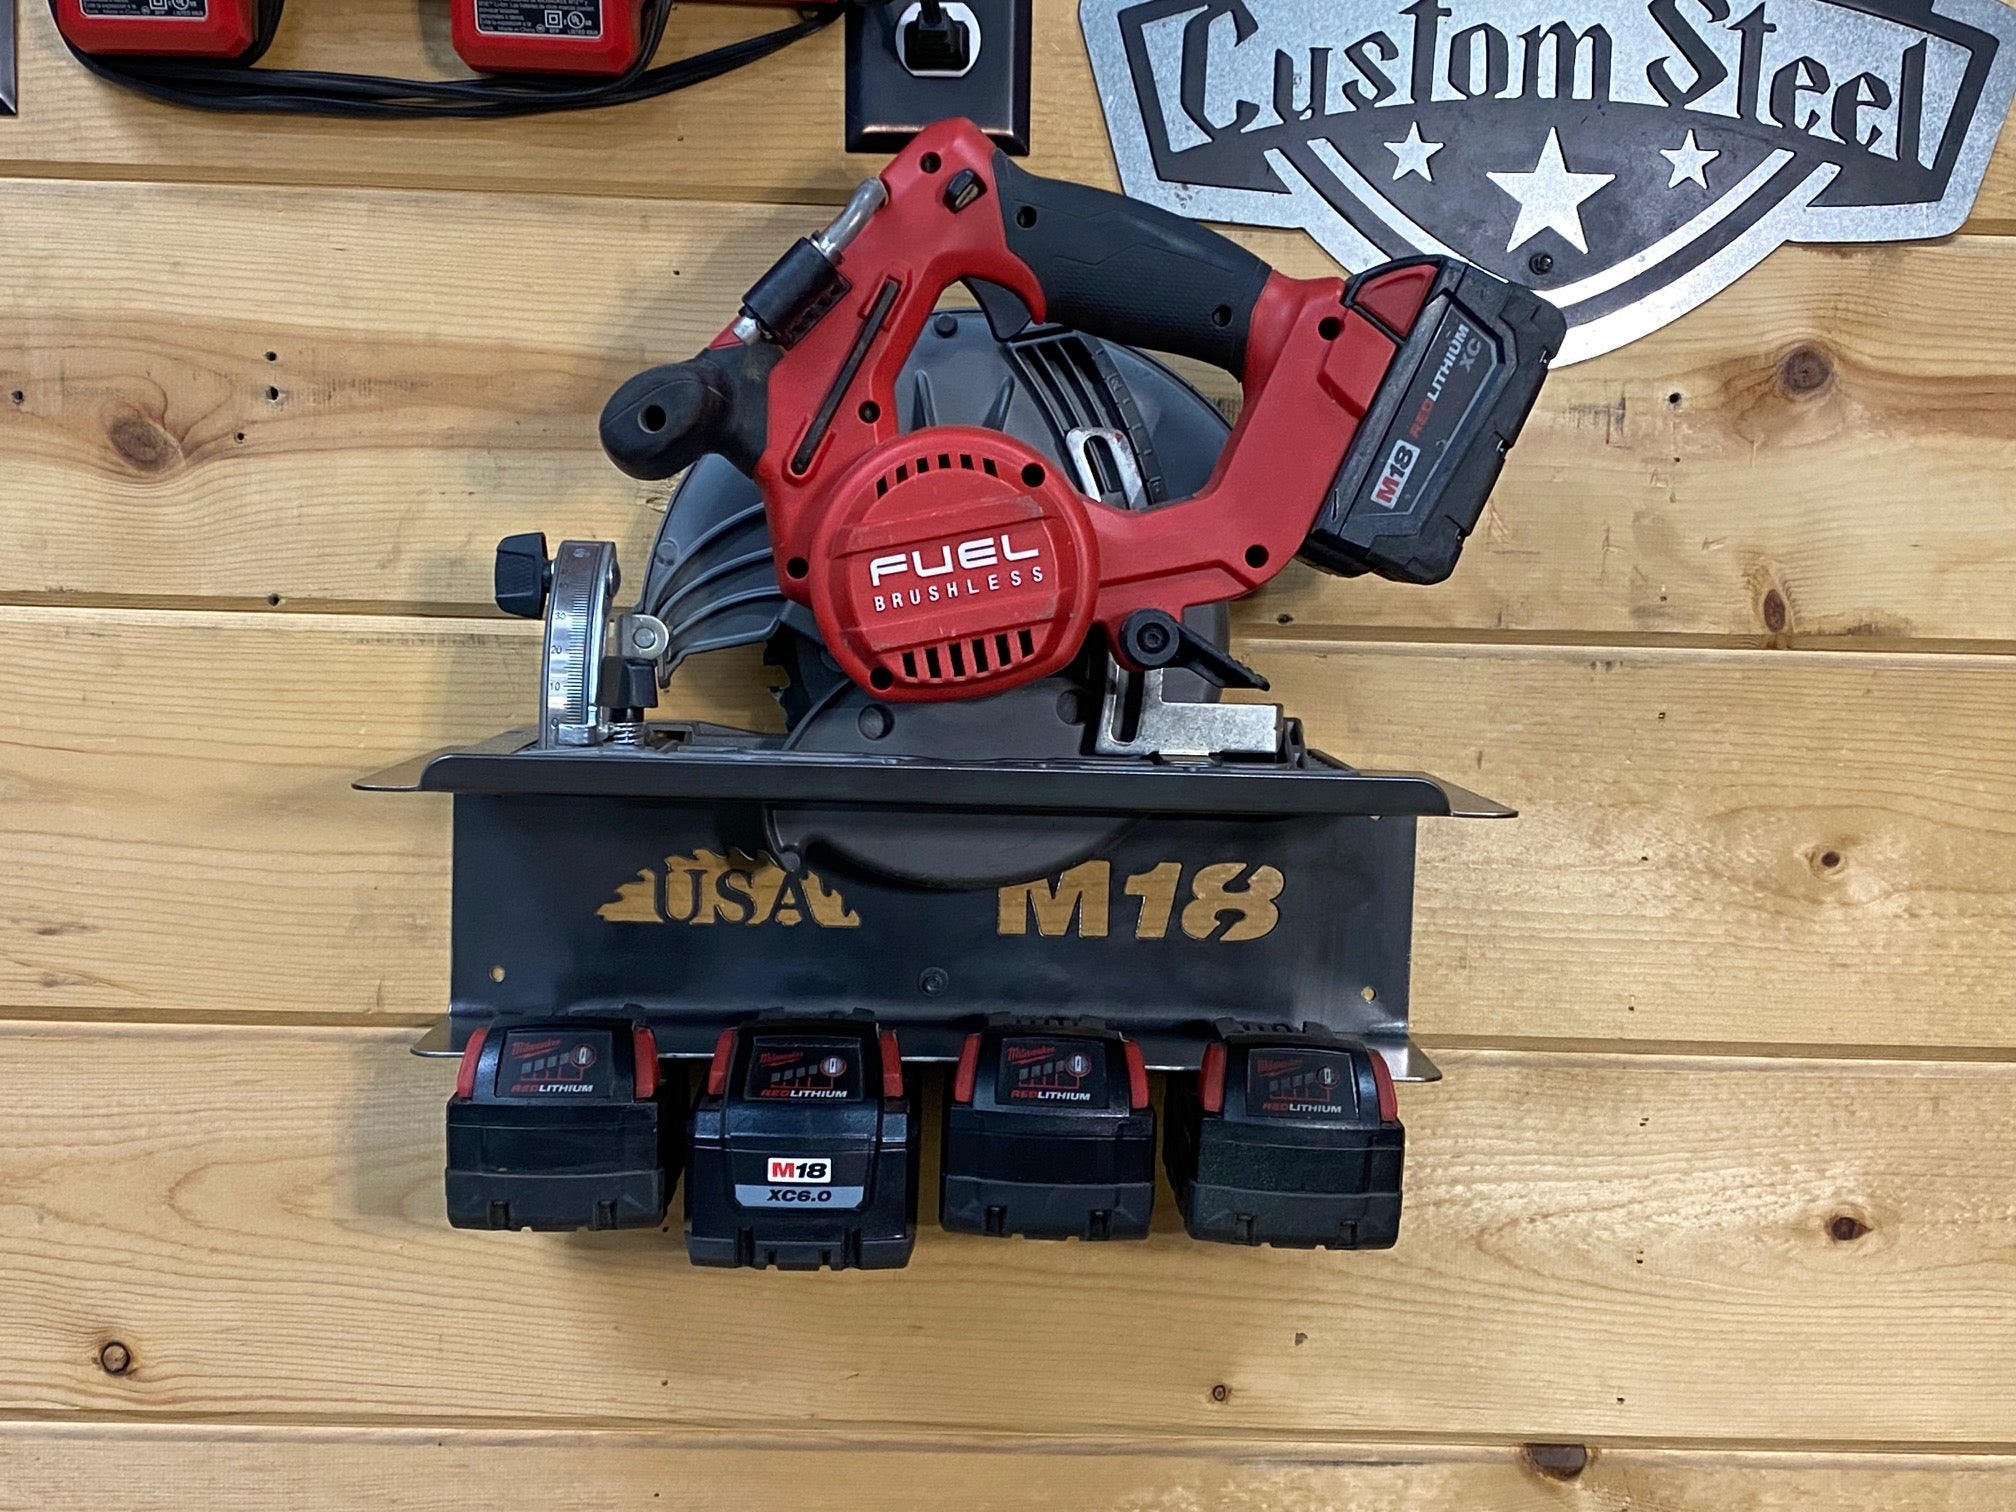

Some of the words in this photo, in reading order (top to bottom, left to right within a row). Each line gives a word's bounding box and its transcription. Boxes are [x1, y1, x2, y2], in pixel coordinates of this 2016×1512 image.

[1179, 0, 1613, 142] Custom
[1645, 0, 1930, 172] Steel
[1458, 339, 1482, 373] XC
[1407, 323, 1470, 438] REDLITHIUM
[1375, 444, 1414, 504] M18
[869, 534, 1040, 587] FUEL
[873, 565, 1044, 612] BRUSHLESS
[550, 645, 563, 655] 20
[549, 681, 561, 692] 10
[653, 868, 822, 926] USA
[997, 860, 1285, 941] M18
[511, 1083, 595, 1094] REDLITHIUM
[1011, 1090, 1092, 1102] REDLITHIUM
[1262, 1102, 1343, 1114] REDLITHIUM
[772, 1162, 828, 1179] M18
[767, 1189, 833, 1203] XC6.0
